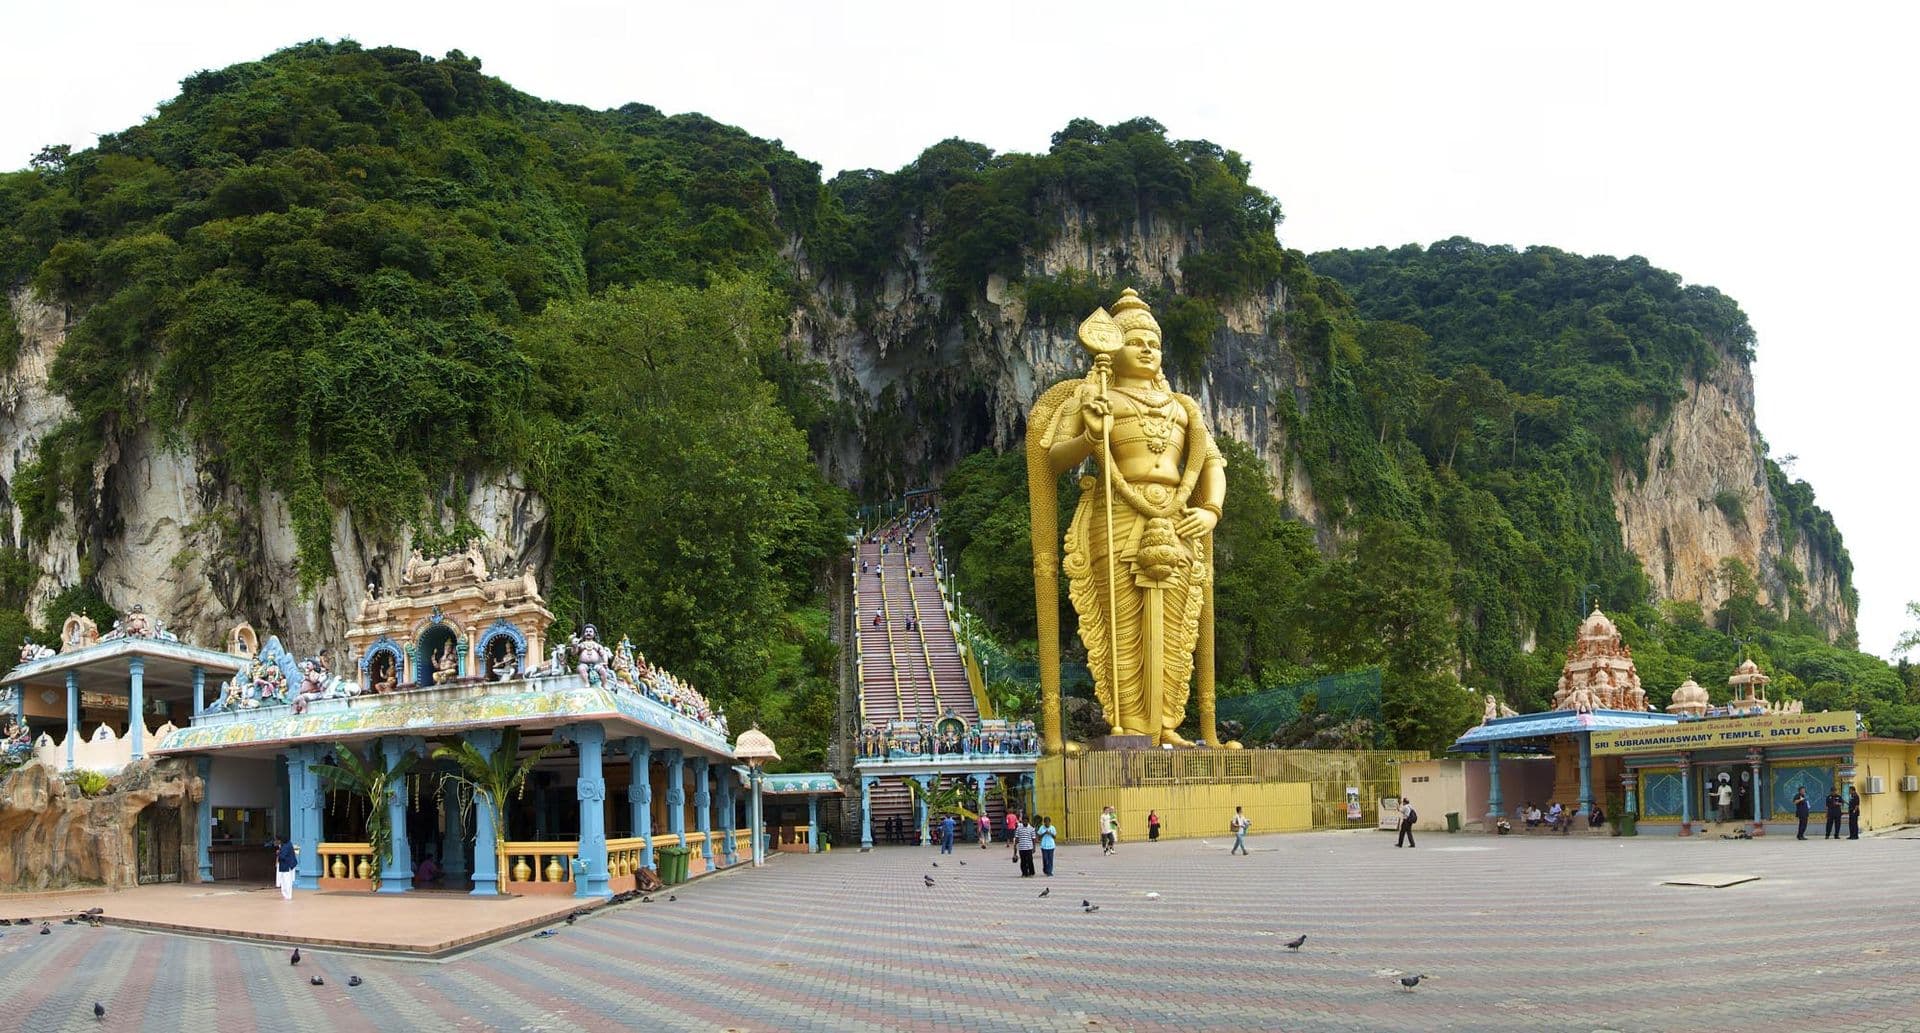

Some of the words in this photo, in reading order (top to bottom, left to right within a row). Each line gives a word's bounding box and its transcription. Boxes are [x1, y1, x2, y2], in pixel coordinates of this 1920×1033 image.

[1594, 741, 1609, 749] SRI
[1614, 734, 1713, 747] SUBRAMANIASWAMY
[1719, 730, 1764, 739] TEMPLE,
[1770, 727, 1801, 737] BATU
[1807, 724, 1850, 734] CAVES.
